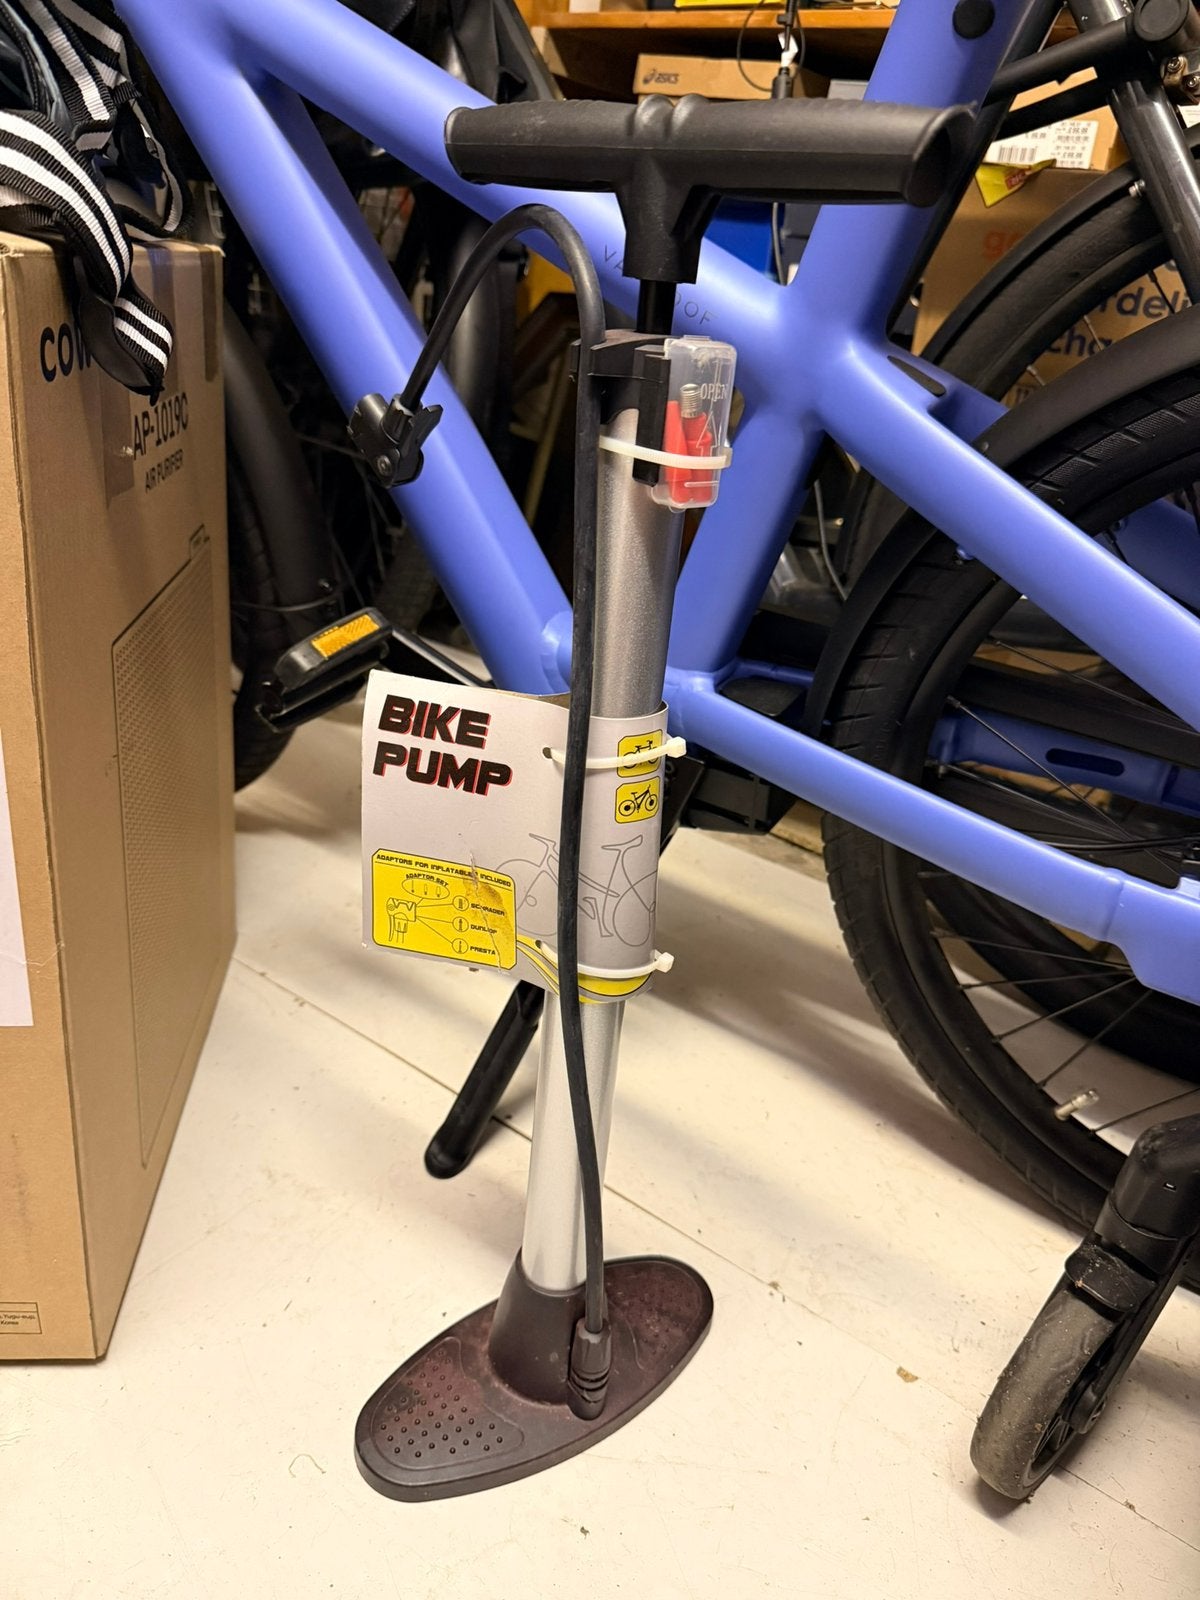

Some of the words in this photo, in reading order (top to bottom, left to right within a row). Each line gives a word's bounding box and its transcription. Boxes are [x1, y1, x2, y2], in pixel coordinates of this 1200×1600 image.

[700, 383, 728, 402] OPEN
[133, 391, 189, 461] AP-1019C
[378, 694, 491, 750] BIKE
[373, 741, 513, 796] PUMP
[376, 854, 413, 866] ADAPTORS
[415, 861, 429, 869] FOR
[480, 873, 512, 888] INCLUDED
[405, 872, 435, 881] ADAPTOR
[436, 877, 449, 888] SET
[470, 924, 498, 934] DUNLOP
[469, 945, 496, 955] PRESTA
